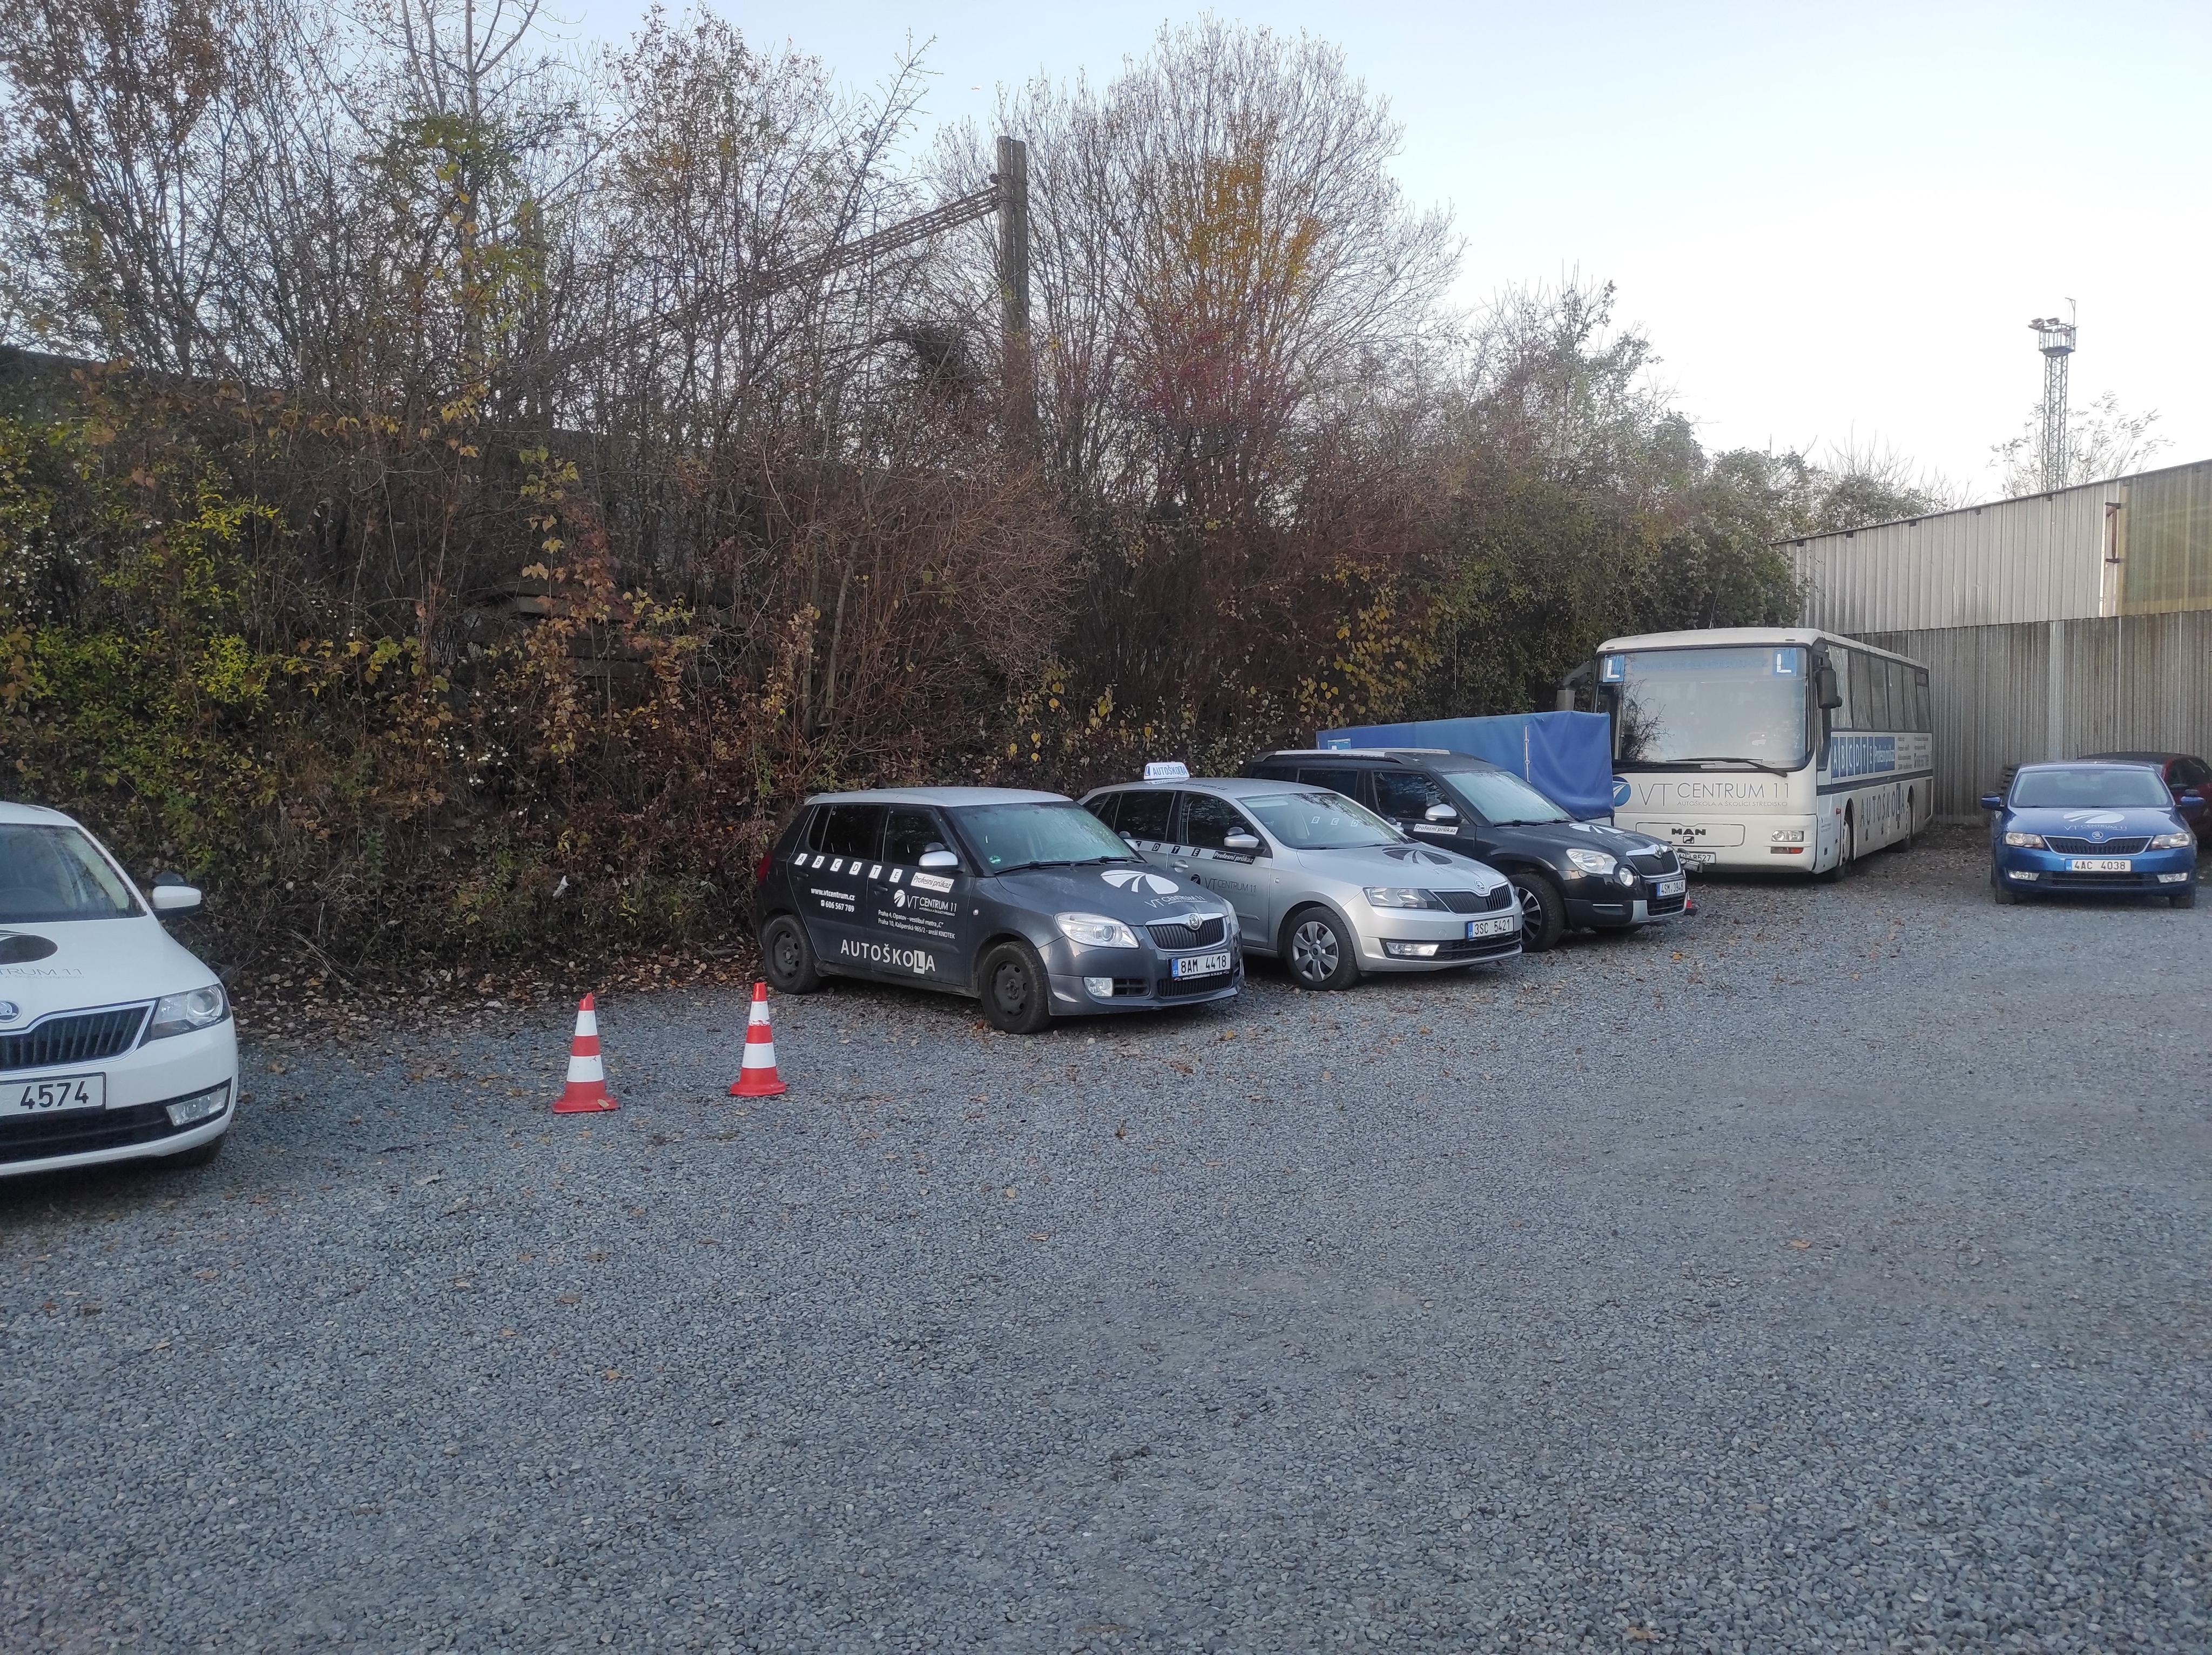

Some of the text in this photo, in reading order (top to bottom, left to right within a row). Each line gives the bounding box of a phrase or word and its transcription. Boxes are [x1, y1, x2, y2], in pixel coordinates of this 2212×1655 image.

[1607, 659, 1620, 679] L
[1776, 653, 1792, 673] L
[1833, 745, 1837, 769] A
[1841, 745, 1845, 769] B
[1849, 744, 1852, 768] C
[1856, 744, 1860, 767] D
[1153, 765, 1188, 776] AUTOŠKOLA
[1638, 782, 1789, 806] VT CENTRUM 11
[1860, 786, 1905, 827] AUTOŠKOLA
[1213, 852, 1236, 860] Profesní
[2074, 861, 2093, 869] 4AC
[2101, 861, 2126, 870] 4038
[913, 875, 934, 886] Profesní
[1205, 877, 1218, 890] VT
[1218, 880, 1249, 891] CENTRUM
[811, 888, 855, 901] www.vtcentrum.cz
[825, 901, 854, 913] 606 567 789
[907, 895, 920, 909] VT
[920, 897, 949, 911] CENTRUM
[950, 901, 956, 913] 11
[1144, 899, 1164, 908] VT
[1475, 919, 1510, 935] 3SC 5421
[840, 939, 936, 974] AUTOŠKOLA
[1181, 955, 1226, 974] 8AM 4418
[20, 1080, 90, 1110] 4574
